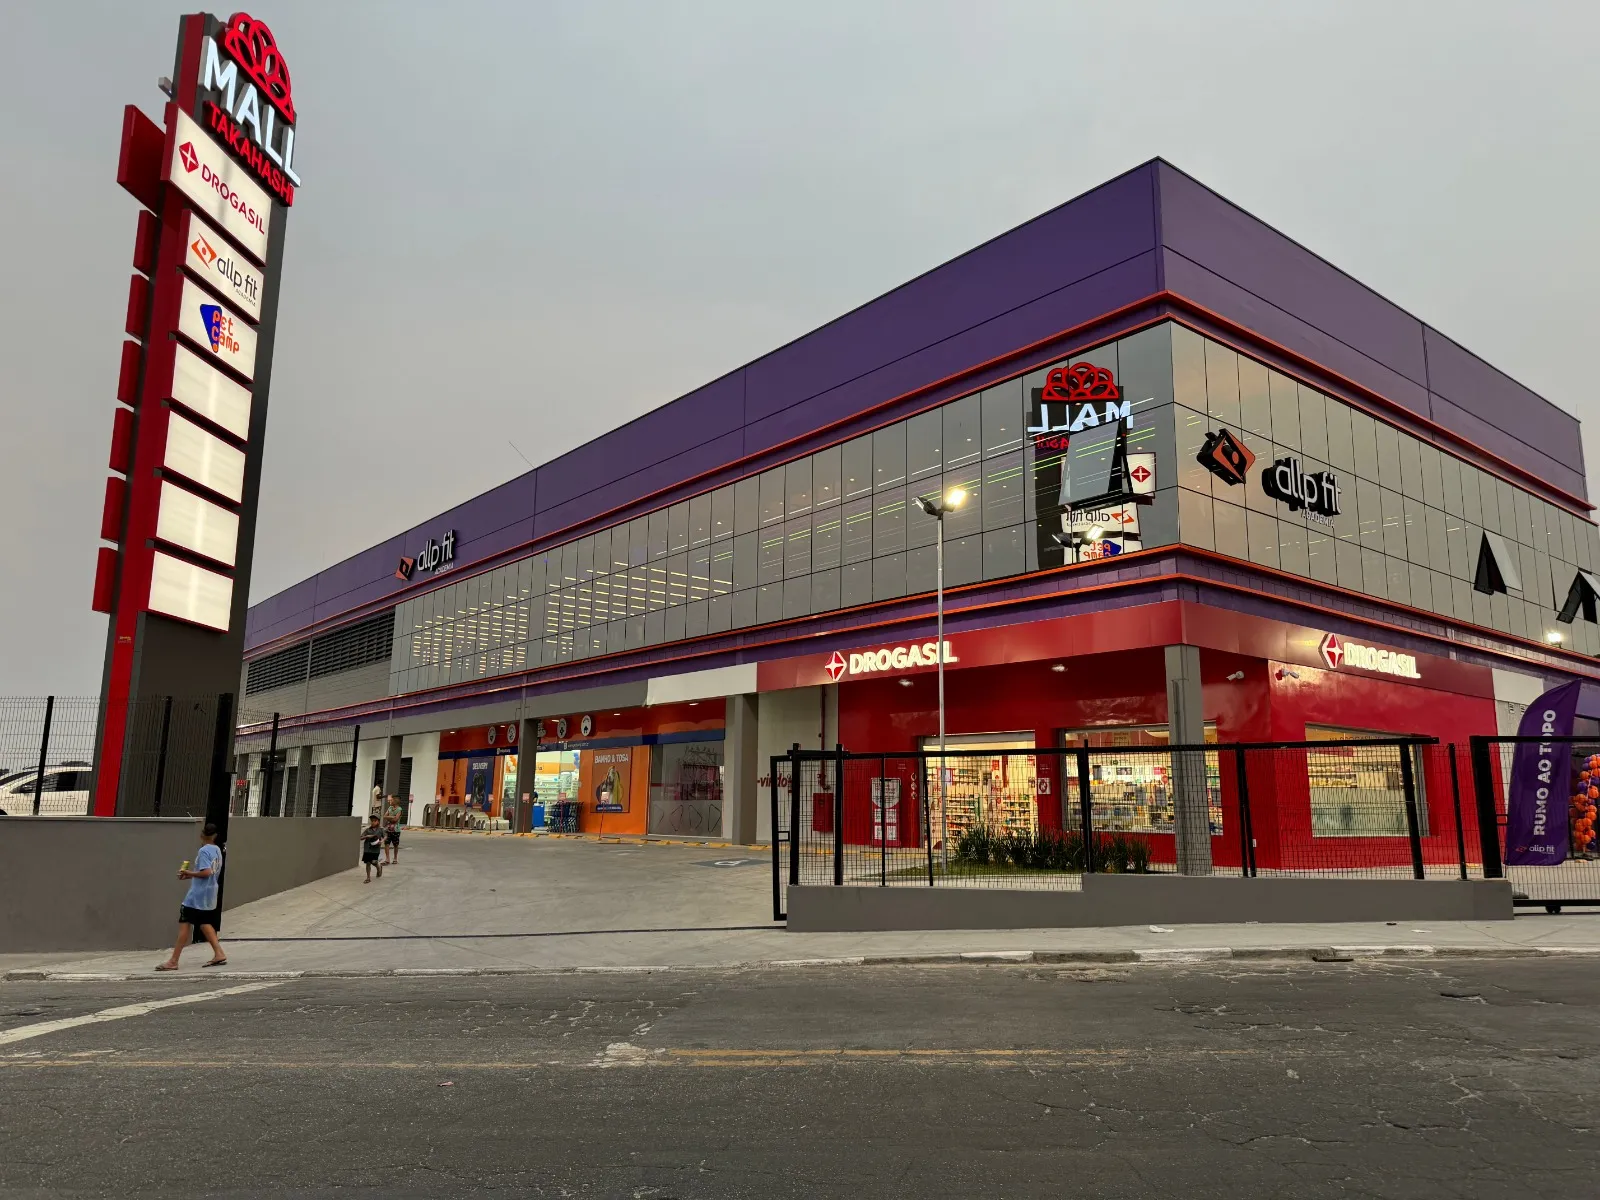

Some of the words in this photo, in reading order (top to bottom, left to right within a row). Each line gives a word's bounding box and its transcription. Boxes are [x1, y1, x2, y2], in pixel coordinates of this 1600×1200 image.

[200, 35, 301, 187] MALL
[204, 101, 295, 206] TAKAHASHI
[201, 163, 265, 236] DROGASIL
[216, 257, 243, 288] allp
[244, 274, 258, 301] fit
[1275, 457, 1319, 508] allp
[1321, 471, 1342, 515] fit
[417, 539, 440, 571] allp
[441, 529, 454, 562] fit
[849, 641, 958, 675] DROGASIL
[1343, 642, 1421, 679] DROGASIL
[472, 762, 488, 770] DELIVERY
[594, 754, 611, 764] BANHO
[616, 753, 629, 763] TOSA
[1537, 759, 1552, 784] AO
[1534, 787, 1549, 836] RUMO
